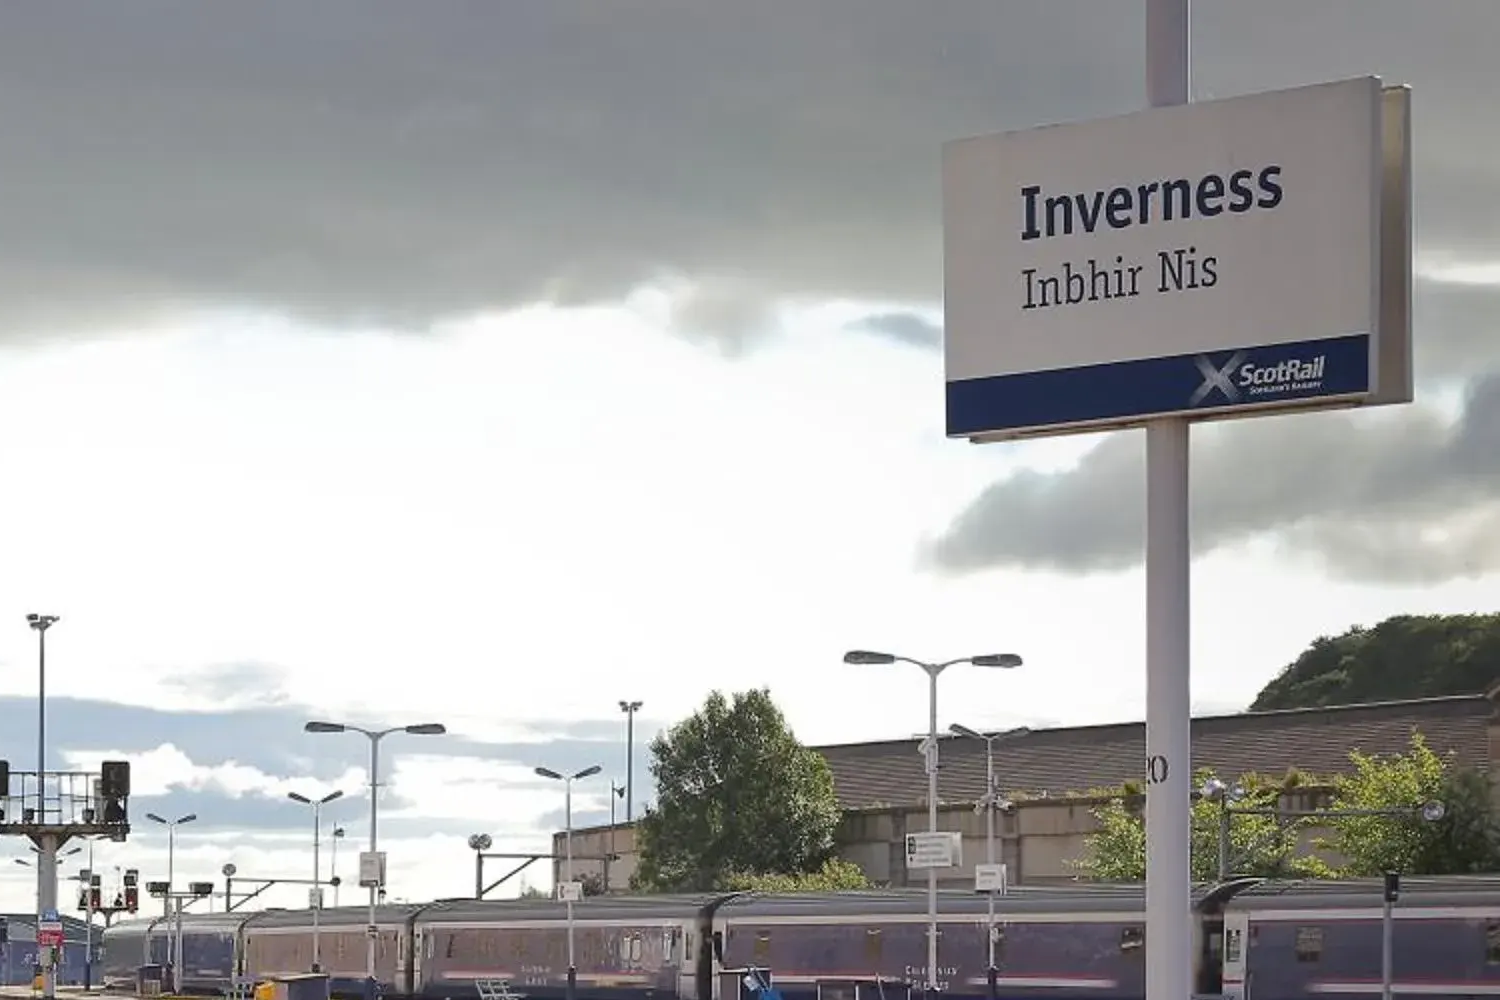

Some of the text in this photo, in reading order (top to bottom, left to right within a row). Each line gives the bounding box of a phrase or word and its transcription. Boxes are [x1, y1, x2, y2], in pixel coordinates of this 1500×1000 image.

[1021, 165, 1283, 240] Inverness
[1022, 246, 1218, 309] Inbhir Nis
[1239, 356, 1325, 386] ScotRail
